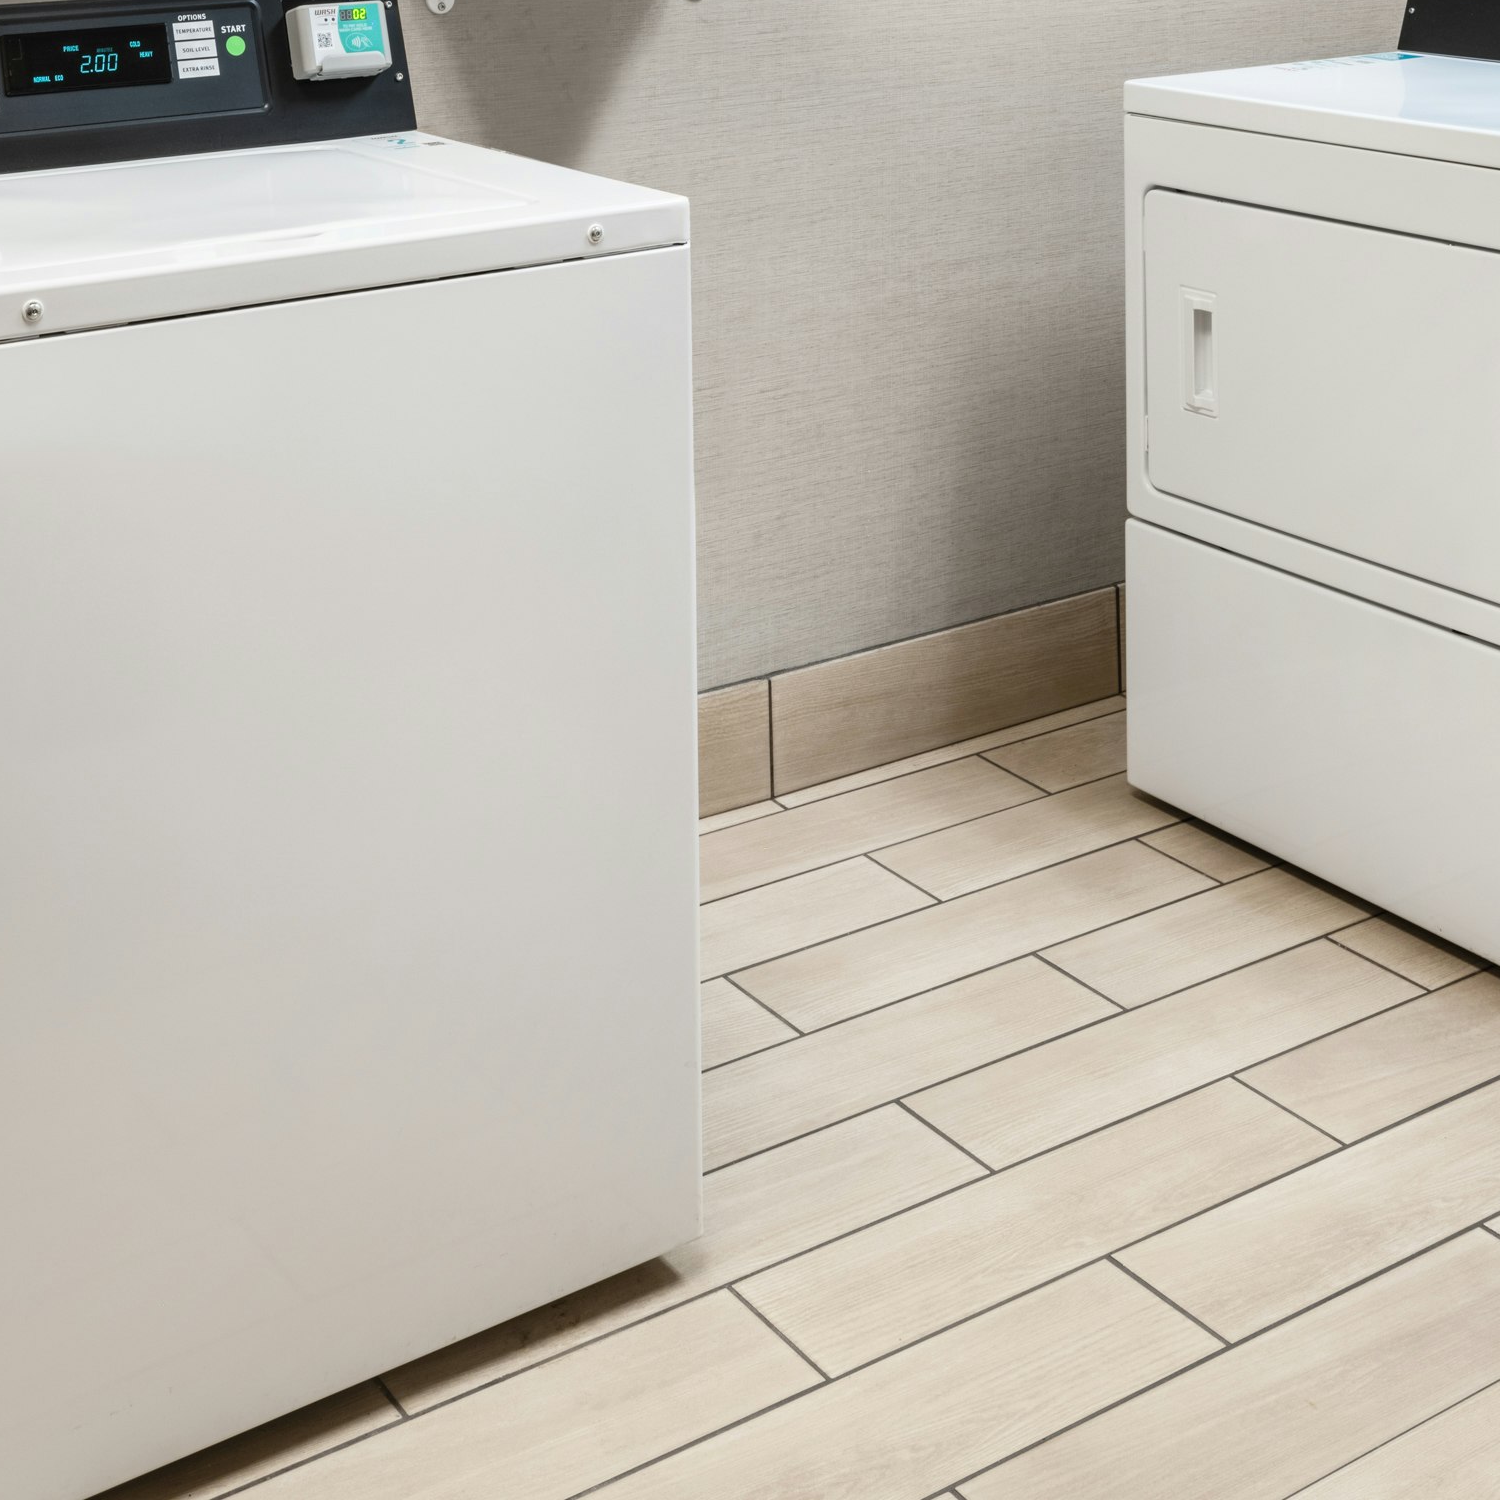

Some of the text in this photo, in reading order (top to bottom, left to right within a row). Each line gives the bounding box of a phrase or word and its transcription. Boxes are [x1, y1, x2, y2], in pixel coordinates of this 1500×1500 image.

[178, 13, 206, 21] OPTIONS
[353, 8, 366, 19] 02
[221, 24, 246, 33] START
[80, 53, 118, 73] 2.00
